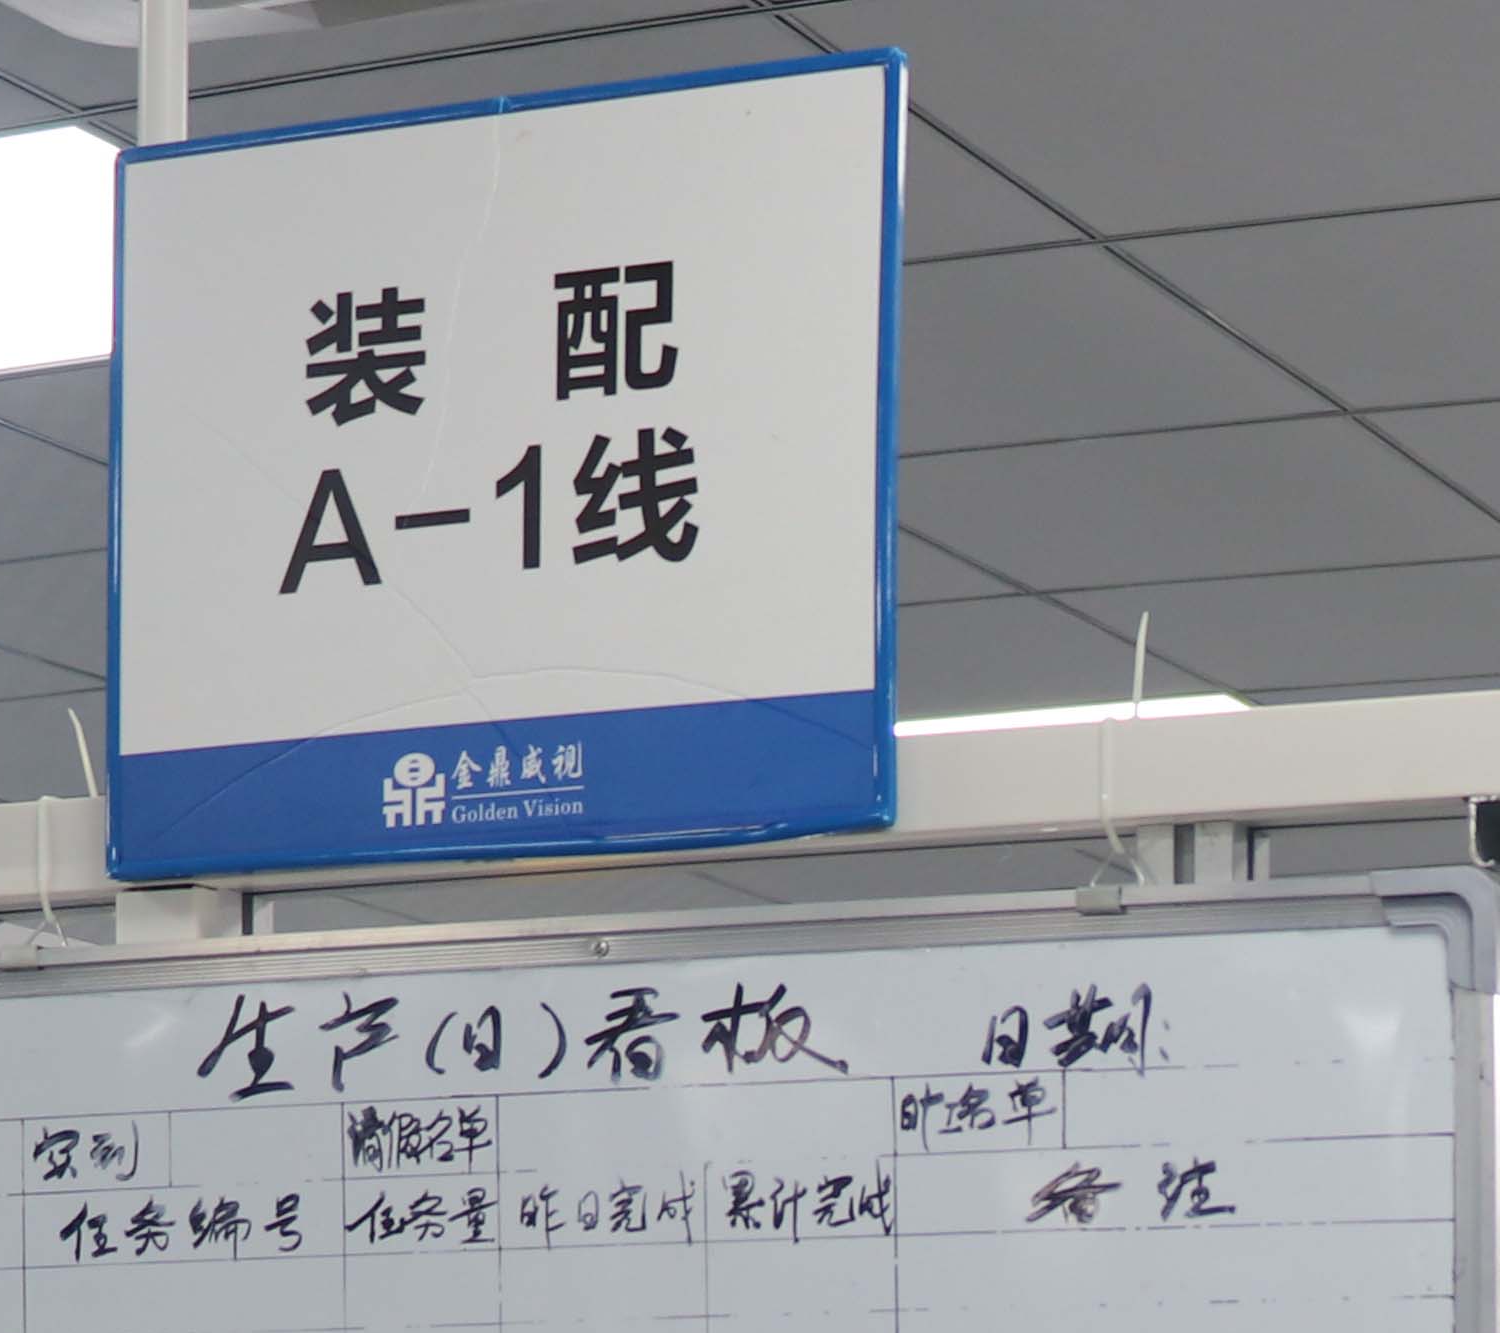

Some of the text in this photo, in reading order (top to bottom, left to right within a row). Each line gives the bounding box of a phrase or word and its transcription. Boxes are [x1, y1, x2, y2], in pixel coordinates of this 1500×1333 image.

[306, 260, 680, 426] 装配
[451, 741, 584, 790] 金鼎威视
[451, 797, 585, 824] Golden Vision
[345, 1187, 498, 1244] 任务量
[520, 1170, 694, 1250] 昨日完成
[724, 1167, 894, 1243] 累计完成
[1025, 1158, 1236, 1224] 备注
[61, 1196, 304, 1263] 任务编号
